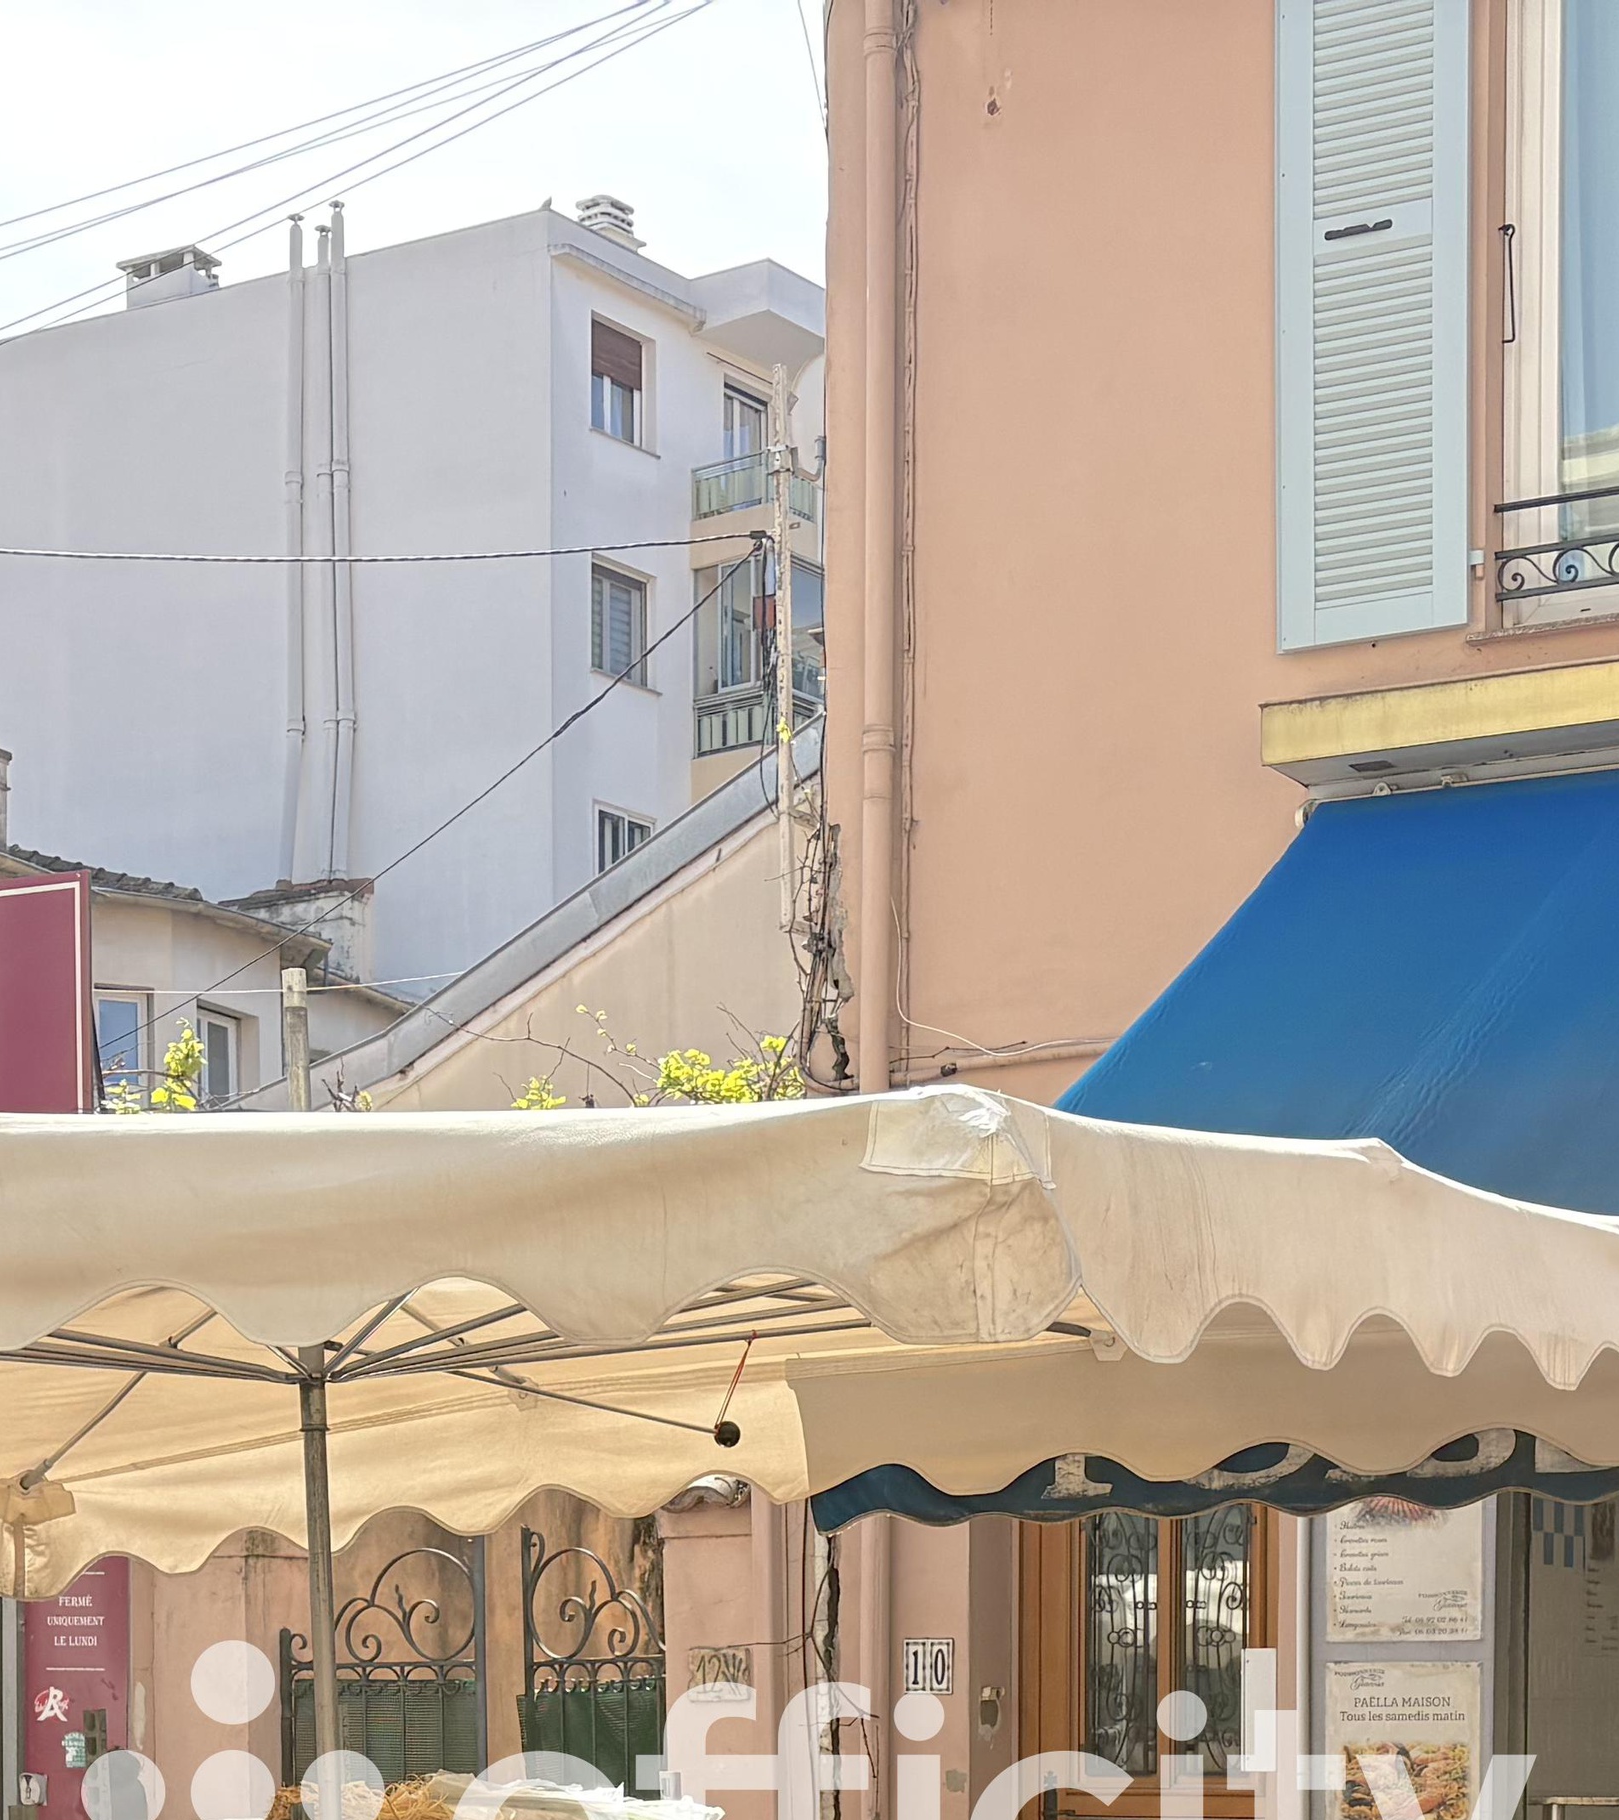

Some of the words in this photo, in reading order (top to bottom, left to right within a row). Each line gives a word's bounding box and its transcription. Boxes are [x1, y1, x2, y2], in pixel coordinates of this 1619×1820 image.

[58, 1595, 93, 1607] FERMÉ
[47, 1616, 105, 1628] UNIQUEMENT
[54, 1636, 67, 1646] LE
[69, 1636, 98, 1647] LUNDI
[911, 1648, 946, 1686] 10
[1354, 1695, 1399, 1707] PAËLLA
[1402, 1696, 1451, 1707] MAISON
[1340, 1711, 1366, 1721] Tous
[1368, 1711, 1383, 1721] les
[1385, 1711, 1430, 1721] samedis
[1432, 1711, 1465, 1721] matin
